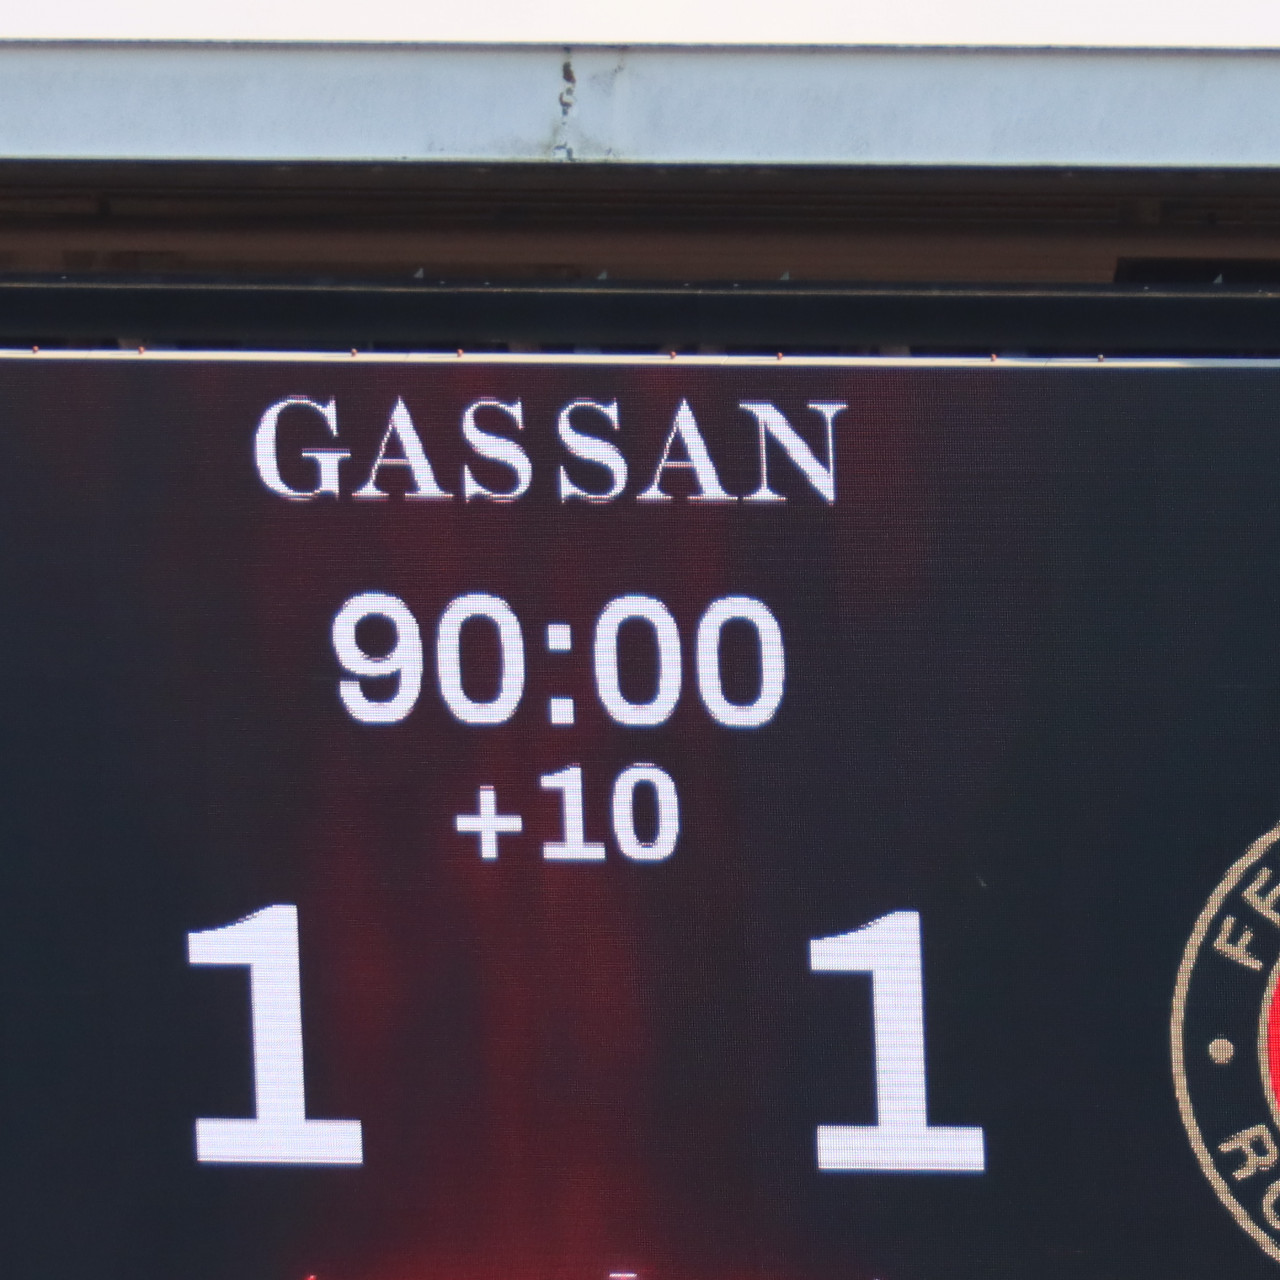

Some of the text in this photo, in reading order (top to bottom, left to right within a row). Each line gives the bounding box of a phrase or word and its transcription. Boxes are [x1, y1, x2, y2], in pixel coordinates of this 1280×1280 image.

[253, 395, 849, 503] GASSAN
[332, 593, 784, 726] 90:00
[456, 762, 679, 860] +10
[187, 904, 364, 1164] 1
[809, 910, 986, 1172] 1
